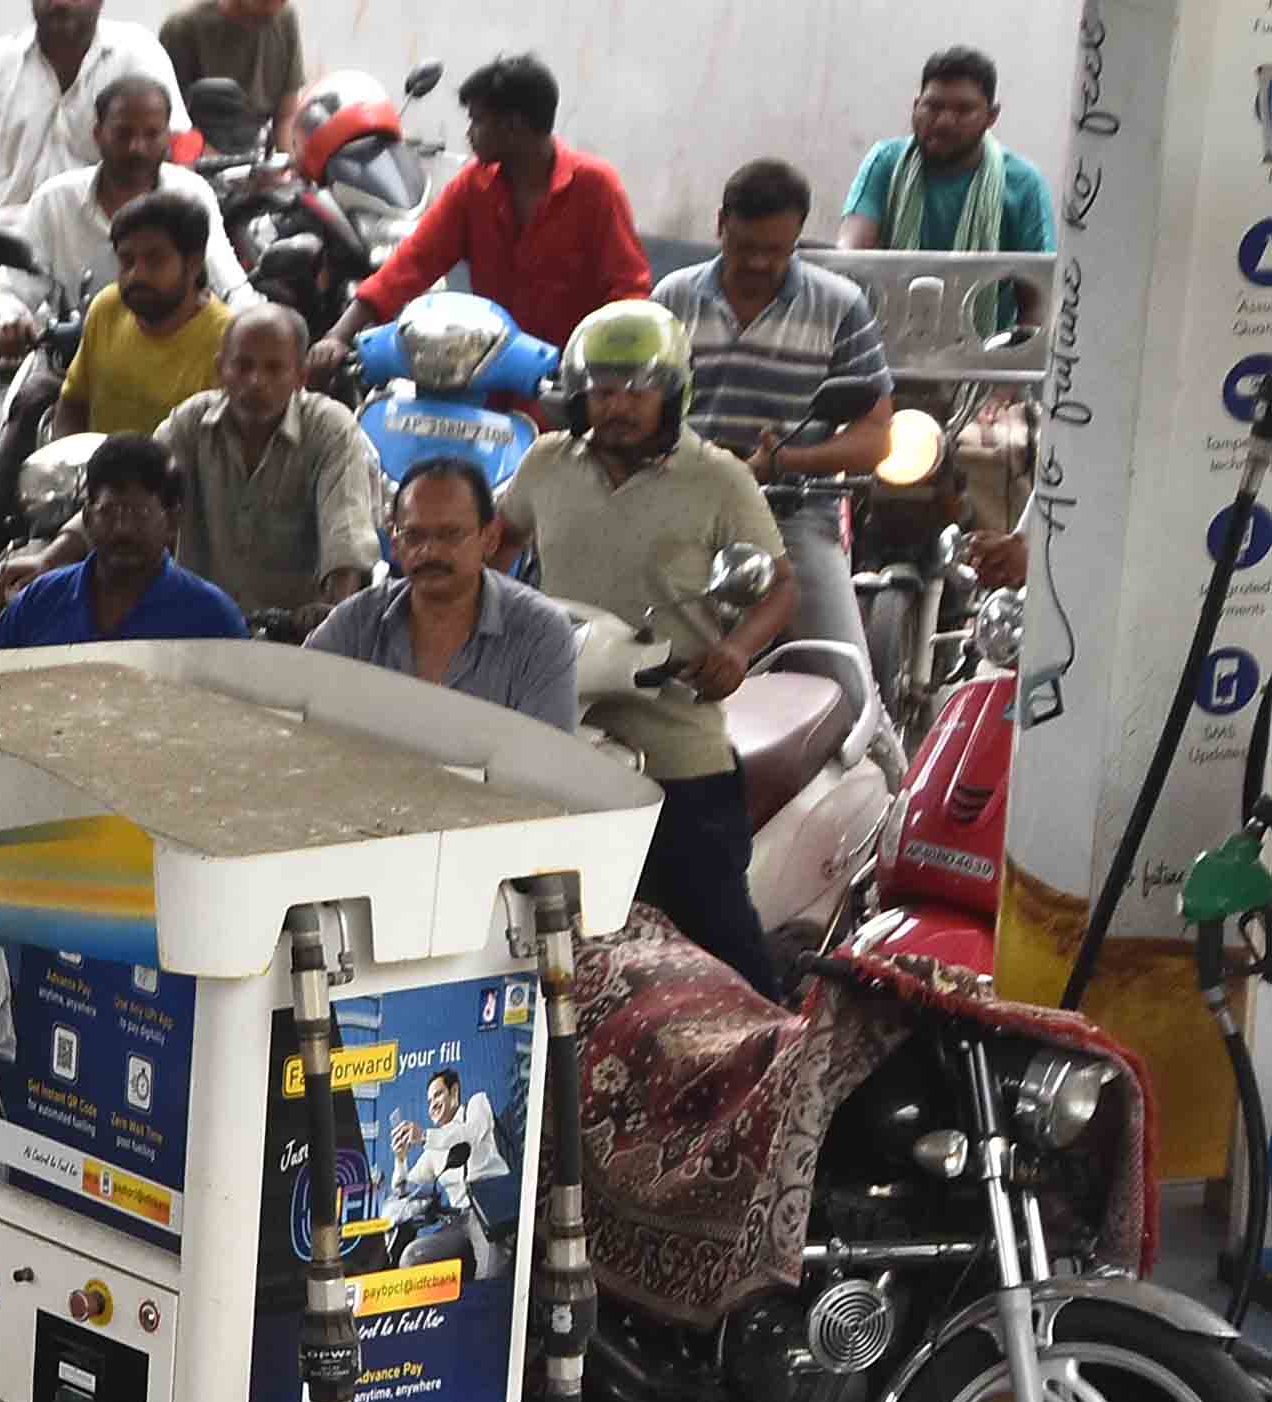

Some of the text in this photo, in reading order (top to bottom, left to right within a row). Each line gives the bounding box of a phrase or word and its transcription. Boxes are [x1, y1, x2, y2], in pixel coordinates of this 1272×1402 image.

[398, 1050, 435, 1076] your
[439, 1040, 462, 1064] fill
[402, 1361, 424, 1379] Pay
[395, 1378, 442, 1400] anywhere
